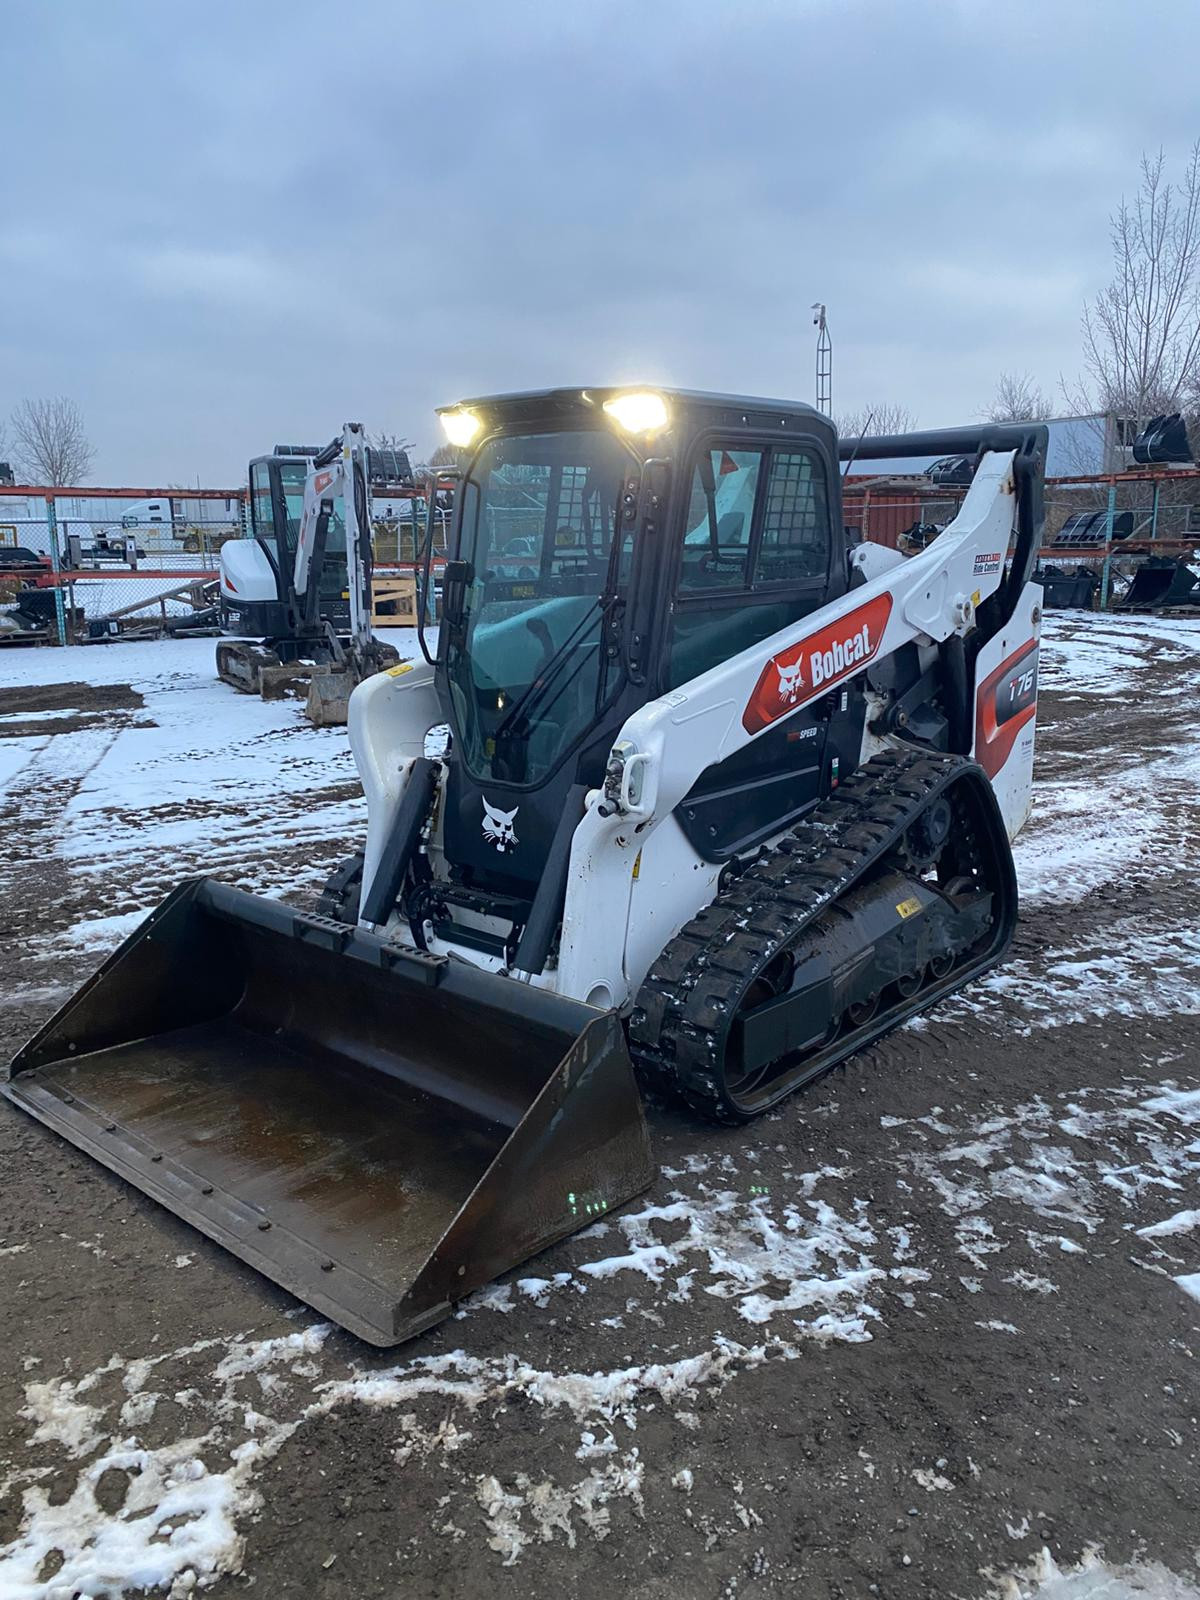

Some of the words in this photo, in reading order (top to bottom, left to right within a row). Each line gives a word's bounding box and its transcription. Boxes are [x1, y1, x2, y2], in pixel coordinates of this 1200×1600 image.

[973, 564, 983, 573] Ride
[984, 562, 1000, 572] Control
[810, 623, 870, 688] Bobcat
[1009, 668, 1034, 701] T76
[799, 726, 818, 740] SPEED
